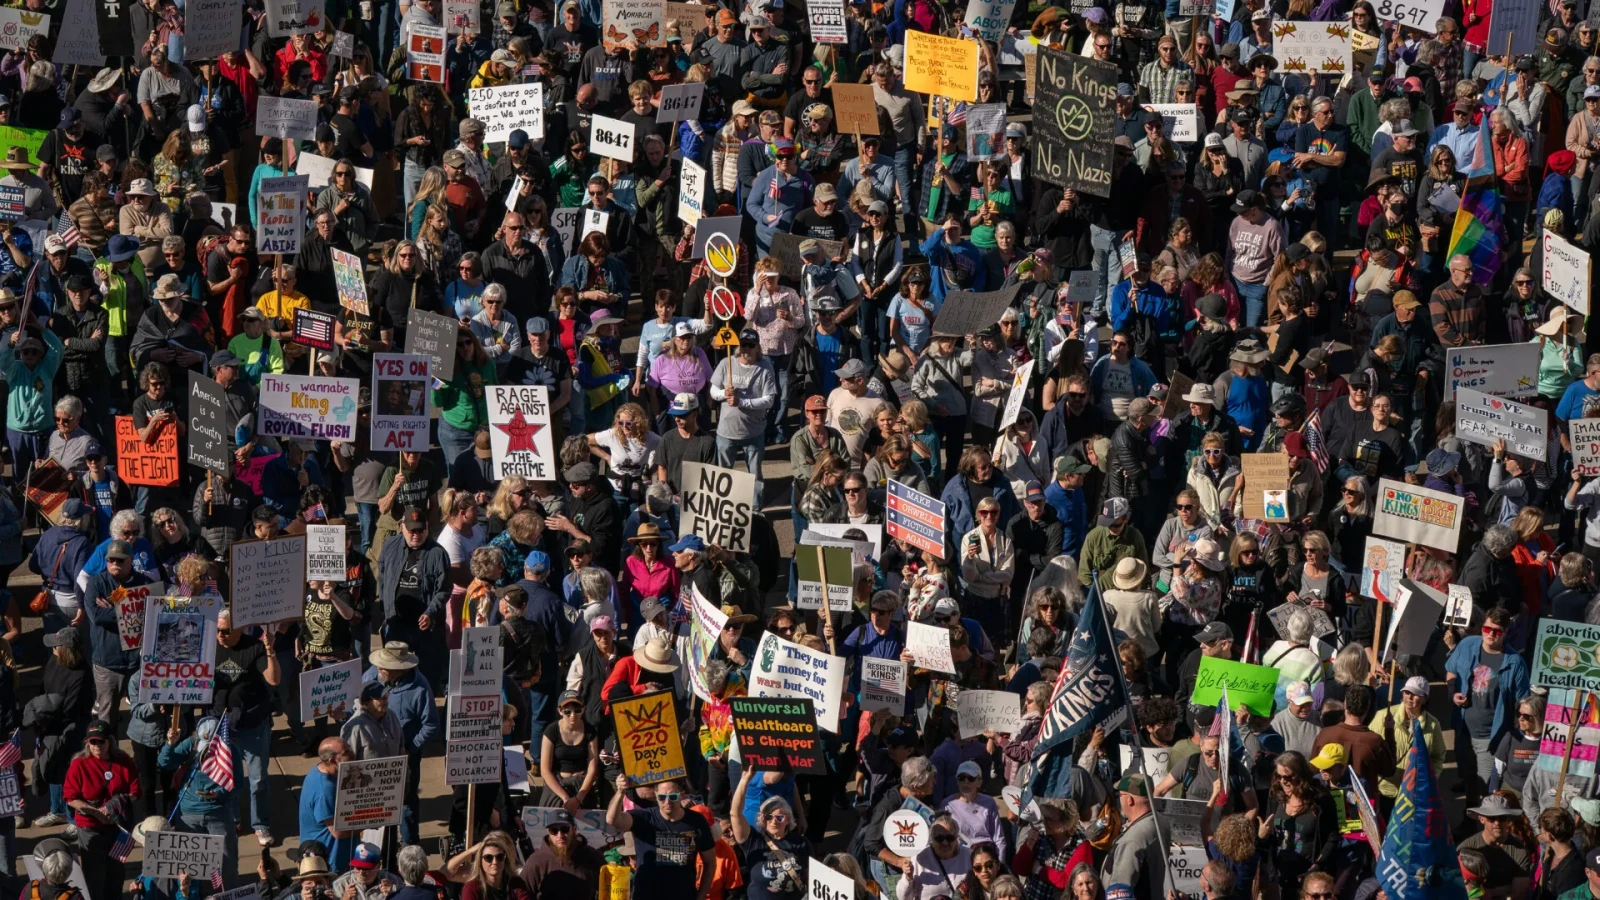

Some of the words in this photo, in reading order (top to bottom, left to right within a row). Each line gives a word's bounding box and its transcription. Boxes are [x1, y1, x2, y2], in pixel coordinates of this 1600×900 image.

[196, 2, 226, 11] COMPLY
[281, 2, 302, 16] WHILE
[448, 6, 473, 16] SINCE
[991, 5, 1001, 16] IS
[1377, 0, 1429, 26] 8647
[616, 9, 652, 20] MONARCH
[813, 14, 842, 26] OFF!
[972, 16, 1007, 29] ABOVE
[980, 29, 1001, 41] THE
[1040, 54, 1067, 90] No
[1071, 61, 1117, 108] Kings
[471, 88, 494, 102] 250
[498, 90, 520, 101] years
[524, 88, 539, 98] ago
[663, 95, 698, 111] 8647
[267, 109, 309, 120] IMPEACH
[840, 110, 871, 122] TRUMP
[1170, 108, 1194, 117] KINGS
[595, 128, 630, 149] 8647
[67, 156, 82, 167] NO
[1037, 141, 1062, 177] No
[1067, 148, 1112, 185] Nazis
[60, 164, 88, 175] KINGS
[682, 168, 697, 186] Just
[686, 183, 697, 197] Try
[680, 190, 701, 212] VIAGRA
[260, 211, 293, 226] PEOPLE
[261, 237, 296, 252] ABIDE
[1253, 234, 1263, 246] BE
[1545, 234, 1579, 270] GUARDIANS
[297, 309, 332, 323] PRO-AMERICA
[346, 319, 373, 331] RESIST
[413, 336, 438, 352] STRONGER
[375, 360, 404, 377] YES
[409, 361, 428, 377] ON
[264, 378, 290, 393] This
[300, 380, 350, 395] wannabe
[192, 381, 221, 407] America
[495, 388, 540, 403] RAGE
[291, 392, 330, 416] King
[500, 402, 546, 416] AGAINST
[263, 408, 313, 423] Deserves
[319, 413, 325, 422] a
[1461, 403, 1502, 421] trumps
[1510, 420, 1543, 435] FEAR
[191, 416, 222, 446] Country
[263, 419, 306, 437] ROYAL
[310, 422, 351, 439] FLUSH
[373, 420, 399, 433] VOTING
[402, 420, 427, 431] RIGHTS
[1460, 418, 1487, 433] FEAR
[1489, 426, 1517, 441] elects
[205, 441, 213, 450] of
[384, 431, 415, 448] ACT
[189, 443, 226, 471] Immigrants
[511, 452, 533, 463] THE
[1580, 456, 1599, 464] BUT
[120, 456, 140, 479] THE
[140, 455, 177, 480] FIGHT
[501, 463, 546, 478] REGIME
[403, 479, 429, 491] REGISTER
[699, 466, 733, 498] NO
[906, 489, 931, 508] MAKE
[1396, 490, 1412, 503] NO
[683, 490, 751, 528] KINGS
[901, 503, 935, 525] ORWELL
[1384, 498, 1419, 517] KINGS
[692, 515, 746, 551] EVER
[901, 517, 935, 538] FICTION
[318, 544, 335, 552] YOU
[905, 532, 931, 551] AGAIN
[238, 547, 257, 561] NO
[264, 540, 301, 559] KING
[239, 564, 252, 574] NO
[256, 560, 289, 569] MEDALS
[309, 560, 344, 569] GOVERNED
[129, 586, 150, 601] NO
[802, 596, 814, 604] NOT
[815, 597, 824, 605] MY
[161, 605, 200, 614] AMERICA
[1545, 622, 1600, 642] abortio
[481, 635, 493, 644] WE
[479, 649, 495, 657] ARE
[143, 662, 214, 679] SCHOOL
[479, 663, 493, 671] ALL
[812, 656, 829, 671] got
[866, 662, 901, 674] RESISTING
[318, 673, 331, 684] No
[332, 670, 351, 682] Kings
[777, 664, 812, 681] money
[812, 671, 827, 687] for
[870, 670, 897, 681] KINGS
[311, 685, 323, 697] No
[324, 683, 343, 692] Wars
[461, 679, 497, 687] IMMIGRANTS
[756, 676, 782, 690] wars
[783, 679, 803, 693] but
[803, 686, 825, 703] can't
[151, 692, 161, 701] AT
[167, 692, 175, 701] A
[181, 692, 203, 701] TIME
[865, 692, 885, 702] SINCE
[885, 695, 900, 704] 1776
[966, 692, 997, 705] THE
[1050, 665, 1114, 734] KINGS
[466, 700, 495, 713] STOP
[732, 700, 807, 715] Universal
[961, 705, 996, 719] WRONG
[1000, 704, 1020, 715] ICE
[450, 719, 490, 728] DEPORTATION
[735, 717, 814, 733] Healthcare
[966, 719, 976, 731] IS
[979, 714, 1021, 727] MELTING
[450, 729, 490, 739] KIDNAPPING
[631, 729, 669, 751] 220
[1542, 723, 1583, 747] Kins
[449, 742, 501, 753] DEMOCRACY
[634, 746, 668, 762] Days
[365, 762, 388, 771] COME
[390, 760, 404, 769] ON
[464, 755, 485, 764] NOT
[647, 759, 661, 770] to
[787, 756, 816, 769] War
[373, 768, 402, 778] PEOPLE
[450, 766, 498, 777] OLIGARCHY
[379, 776, 402, 786] NOW
[344, 797, 381, 806] EVERYBODY
[355, 791, 385, 800] BROTHER
[353, 802, 385, 811] TOGETHER
[347, 819, 367, 827] RIGHT
[368, 817, 385, 825] NOW
[157, 833, 213, 851] FIRST
[900, 834, 915, 844] NO
[147, 848, 221, 863] AMENDMENT
[156, 862, 211, 877] FIRST
[1170, 859, 1188, 869] NO
